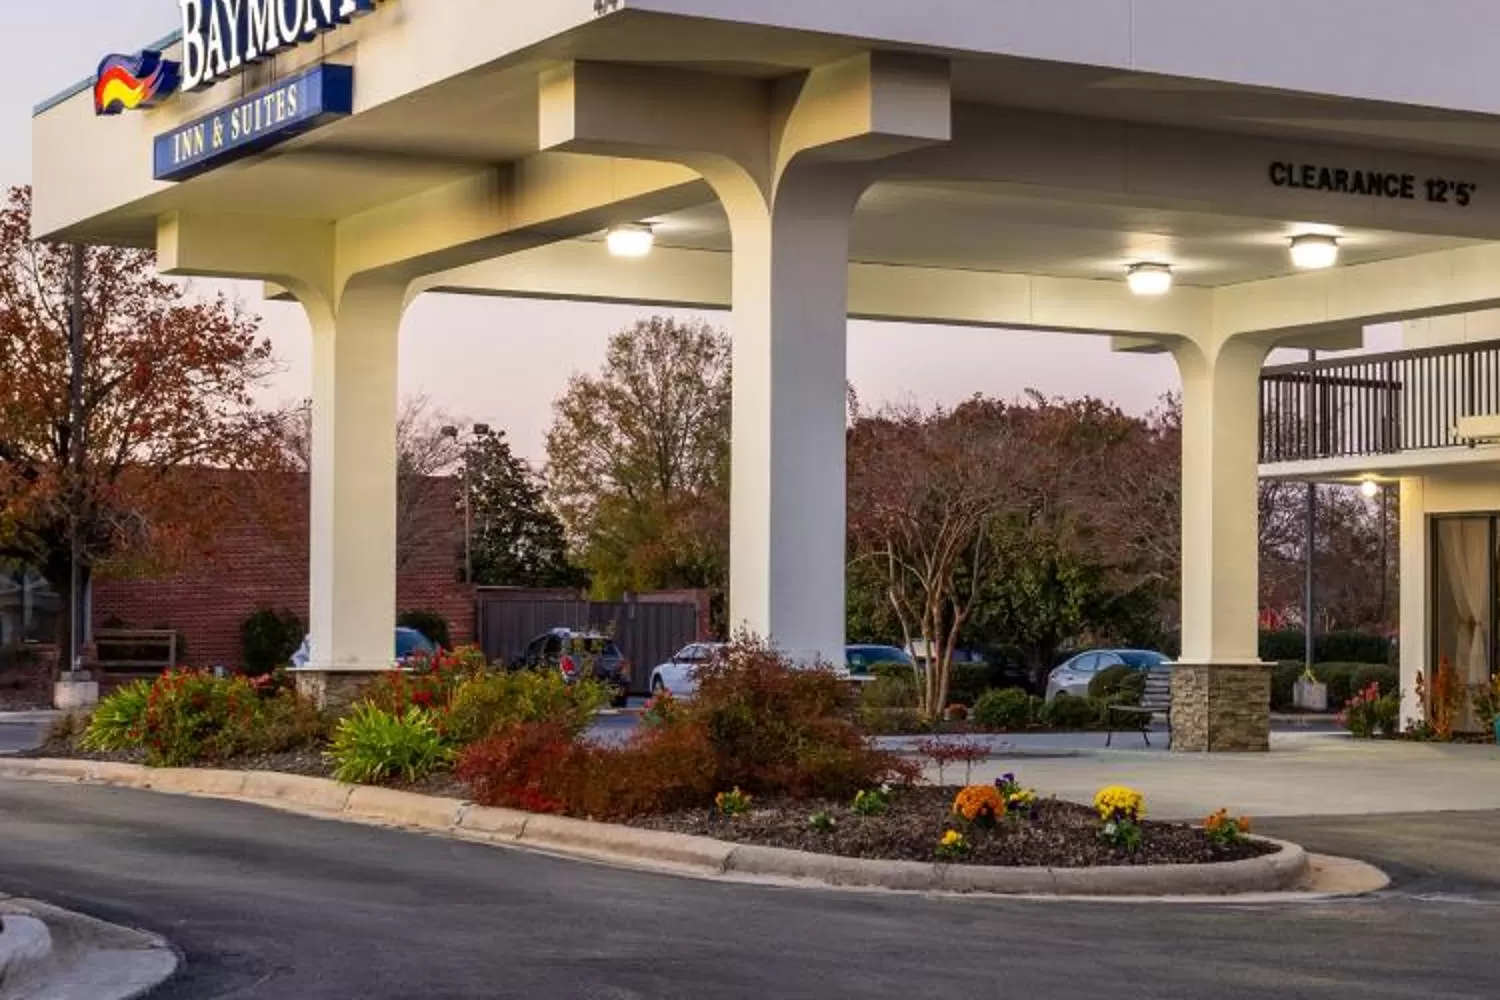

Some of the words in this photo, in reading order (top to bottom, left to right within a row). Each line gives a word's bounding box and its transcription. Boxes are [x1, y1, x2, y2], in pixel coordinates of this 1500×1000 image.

[173, 124, 204, 163] INN
[211, 117, 224, 149] &
[230, 83, 298, 139] SUITES
[1268, 161, 1416, 199] CLEARANCE
